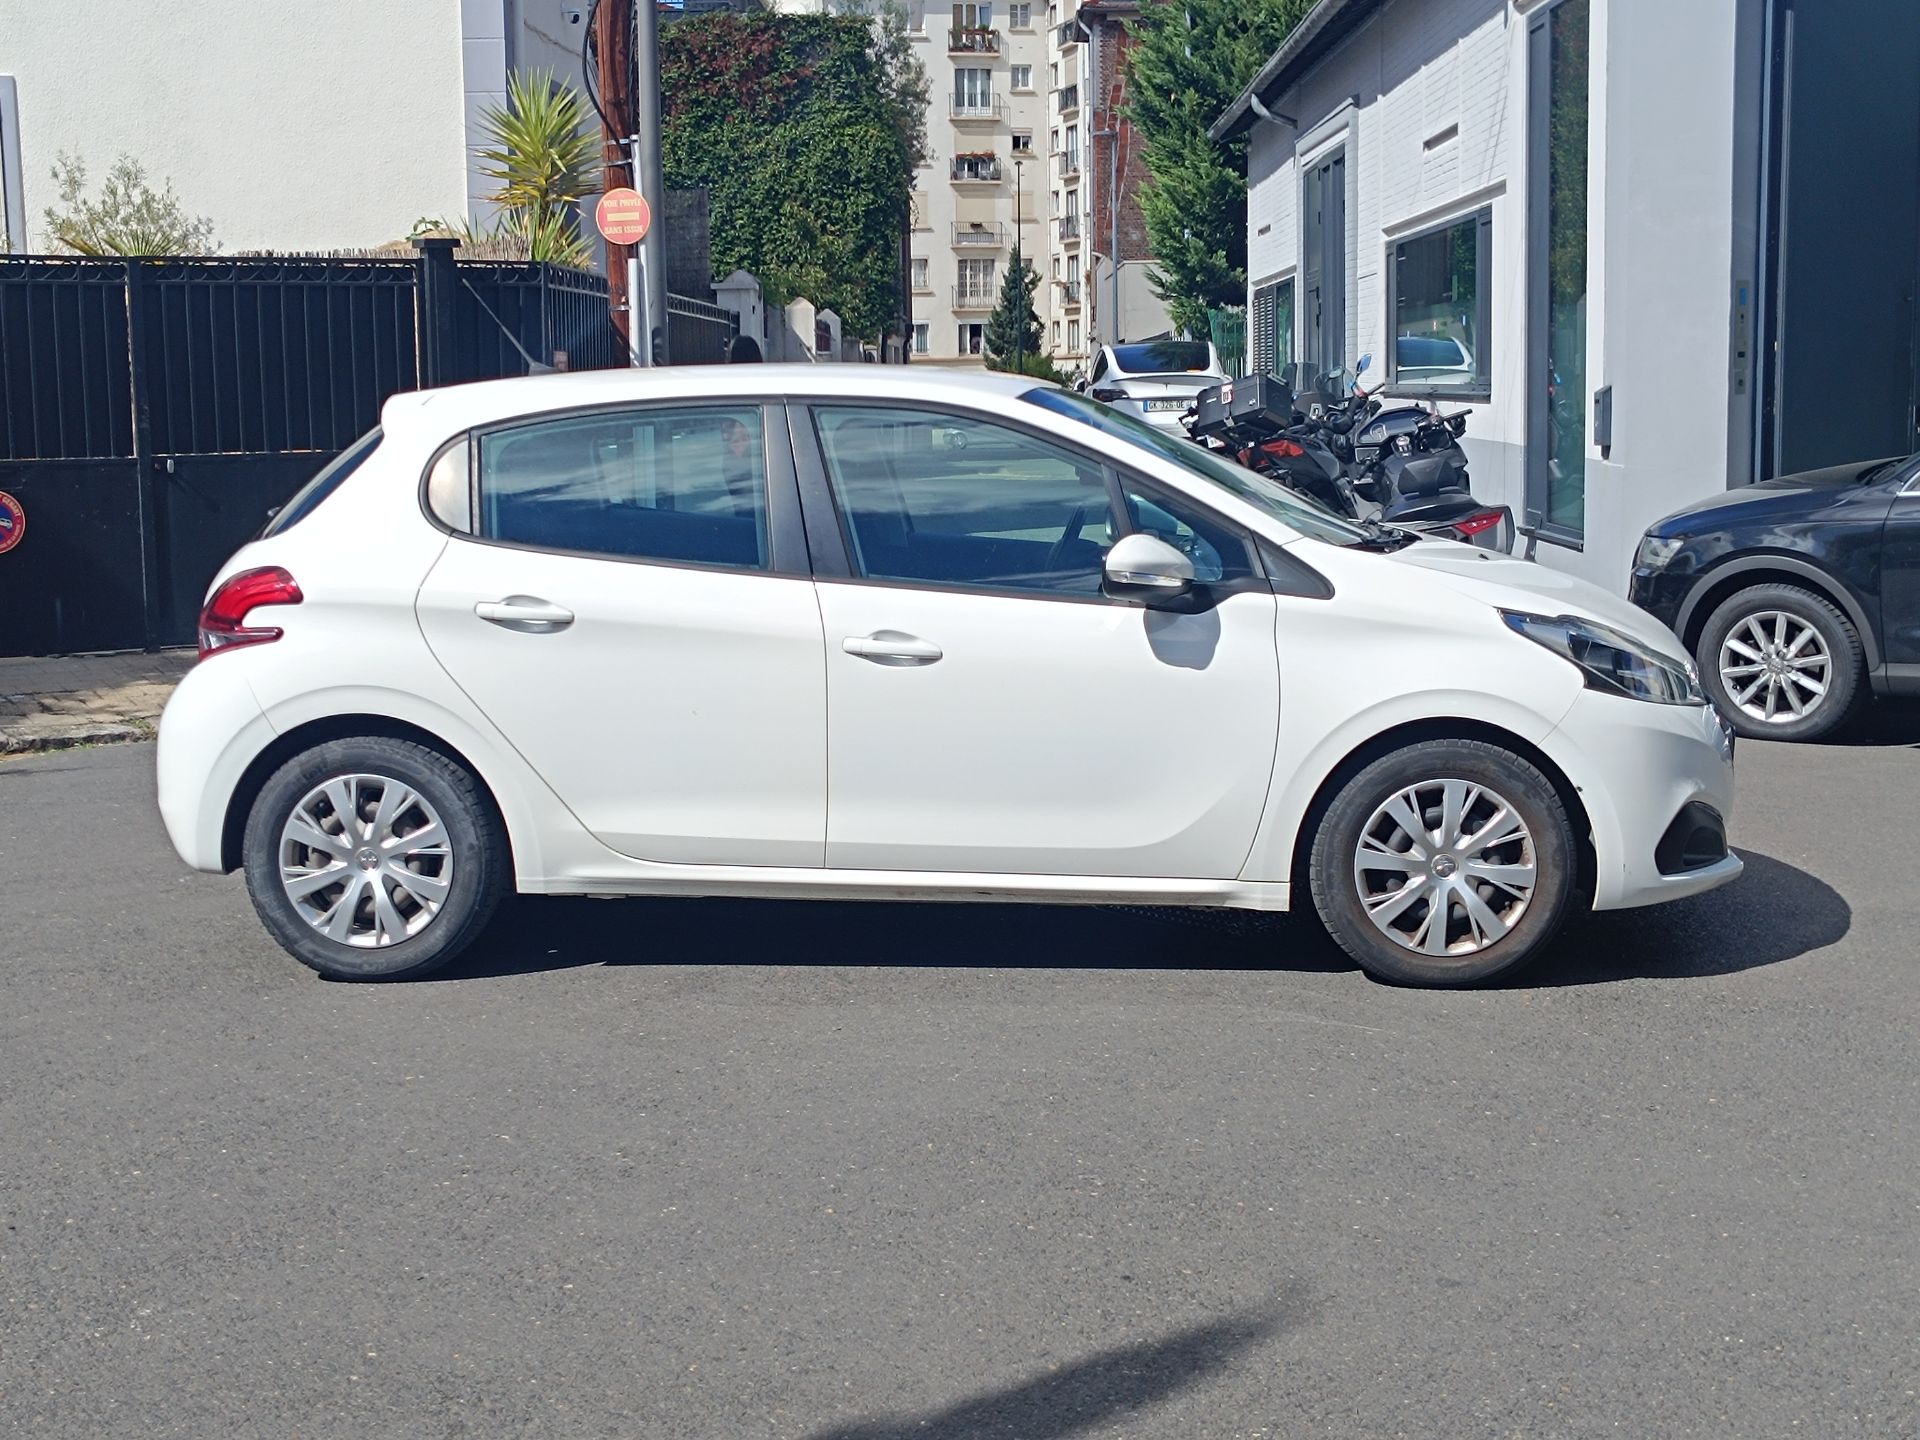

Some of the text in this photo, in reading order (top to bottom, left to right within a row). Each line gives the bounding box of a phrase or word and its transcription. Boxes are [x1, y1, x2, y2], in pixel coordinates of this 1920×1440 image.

[603, 200, 618, 208] VOIE
[604, 225, 643, 235] SANS ISSUE
